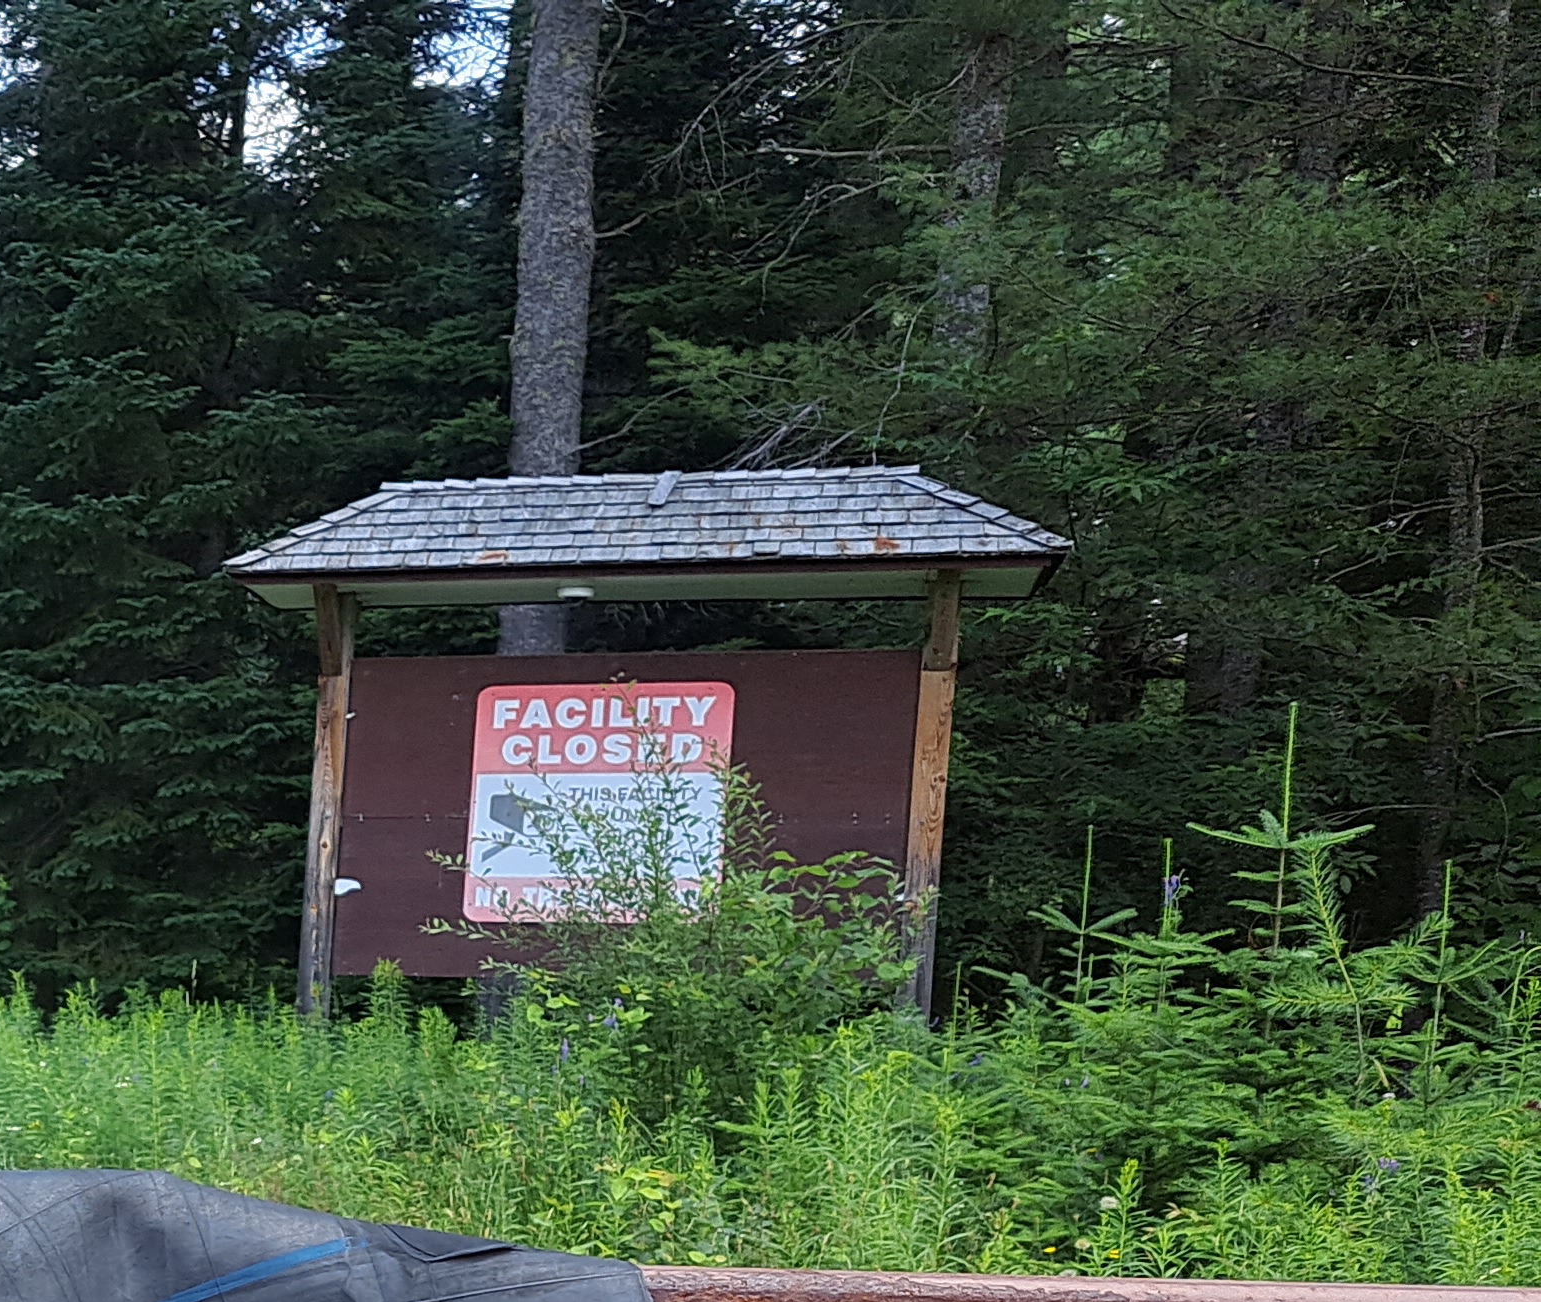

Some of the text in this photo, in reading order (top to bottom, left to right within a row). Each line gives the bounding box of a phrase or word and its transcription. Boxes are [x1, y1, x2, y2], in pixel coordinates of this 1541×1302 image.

[493, 695, 717, 729] FACILITY
[502, 733, 703, 765] CLOSED
[569, 786, 612, 801] THIS
[475, 886, 511, 907] NO
